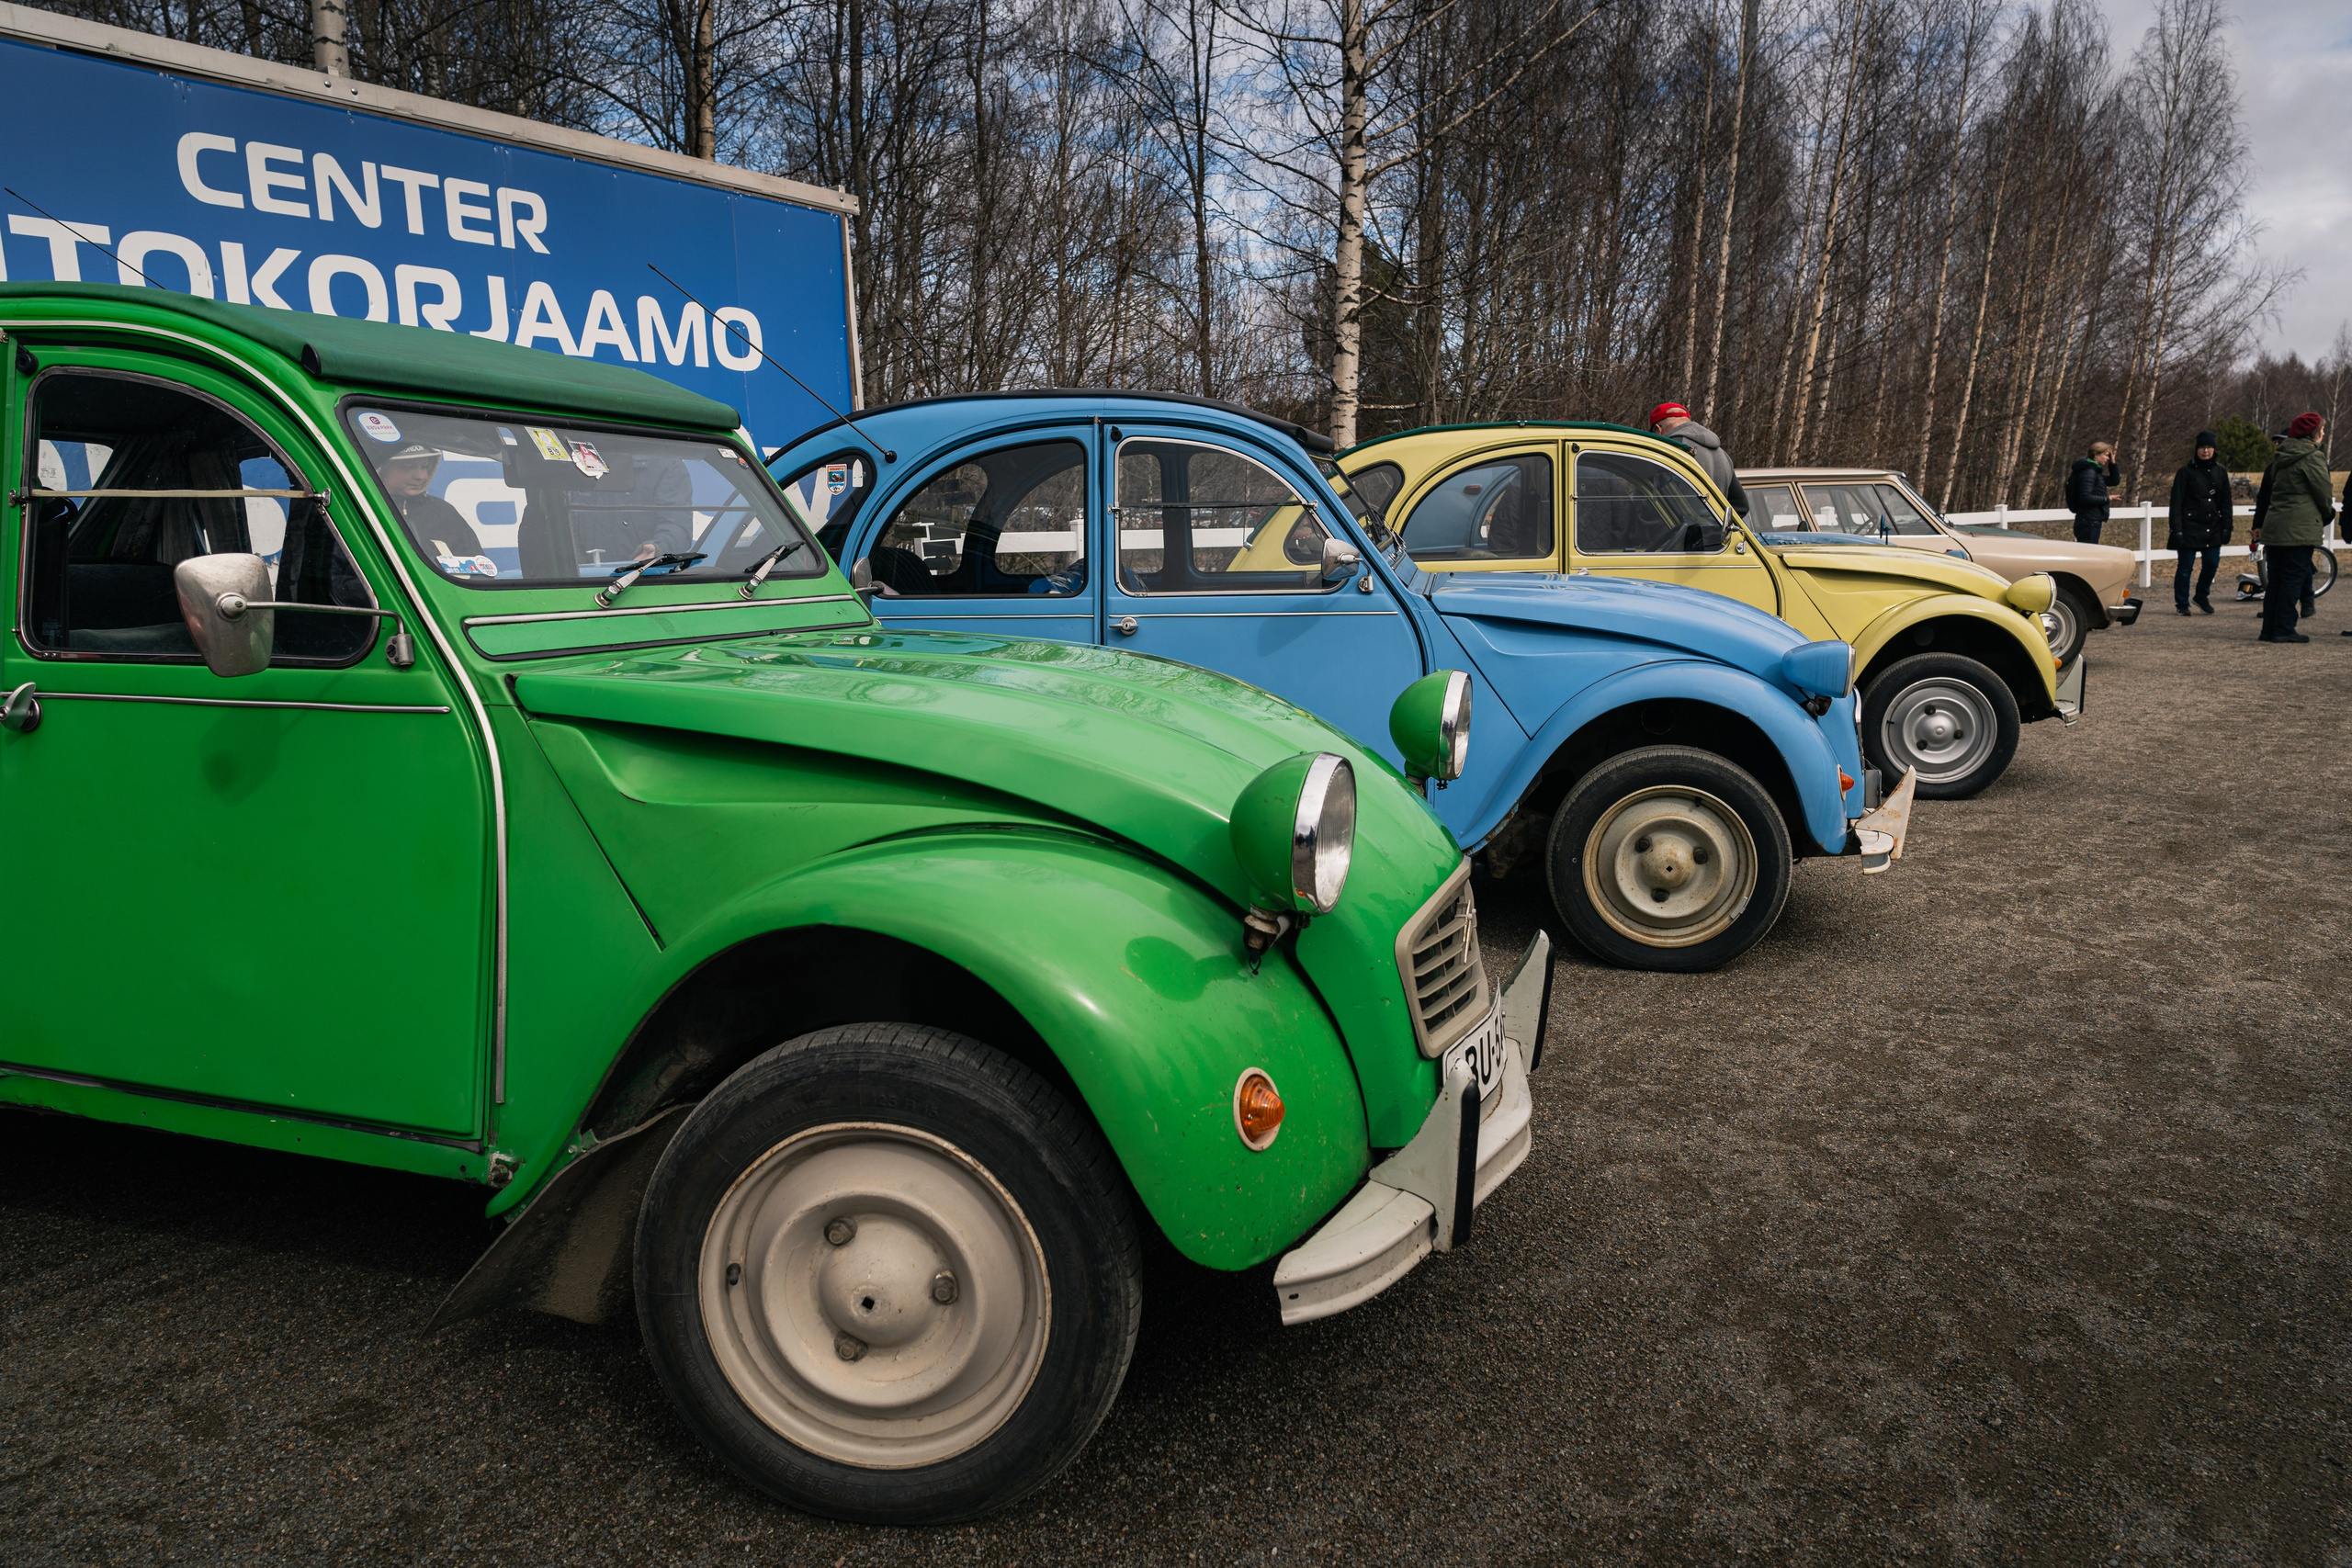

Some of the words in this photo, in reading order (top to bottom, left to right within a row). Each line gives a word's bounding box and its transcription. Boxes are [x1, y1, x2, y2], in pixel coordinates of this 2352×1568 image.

[177, 131, 550, 254] CENTER
[0, 214, 763, 372] TOKORJAAMO
[748, 1441, 864, 1504] MICHELIN
